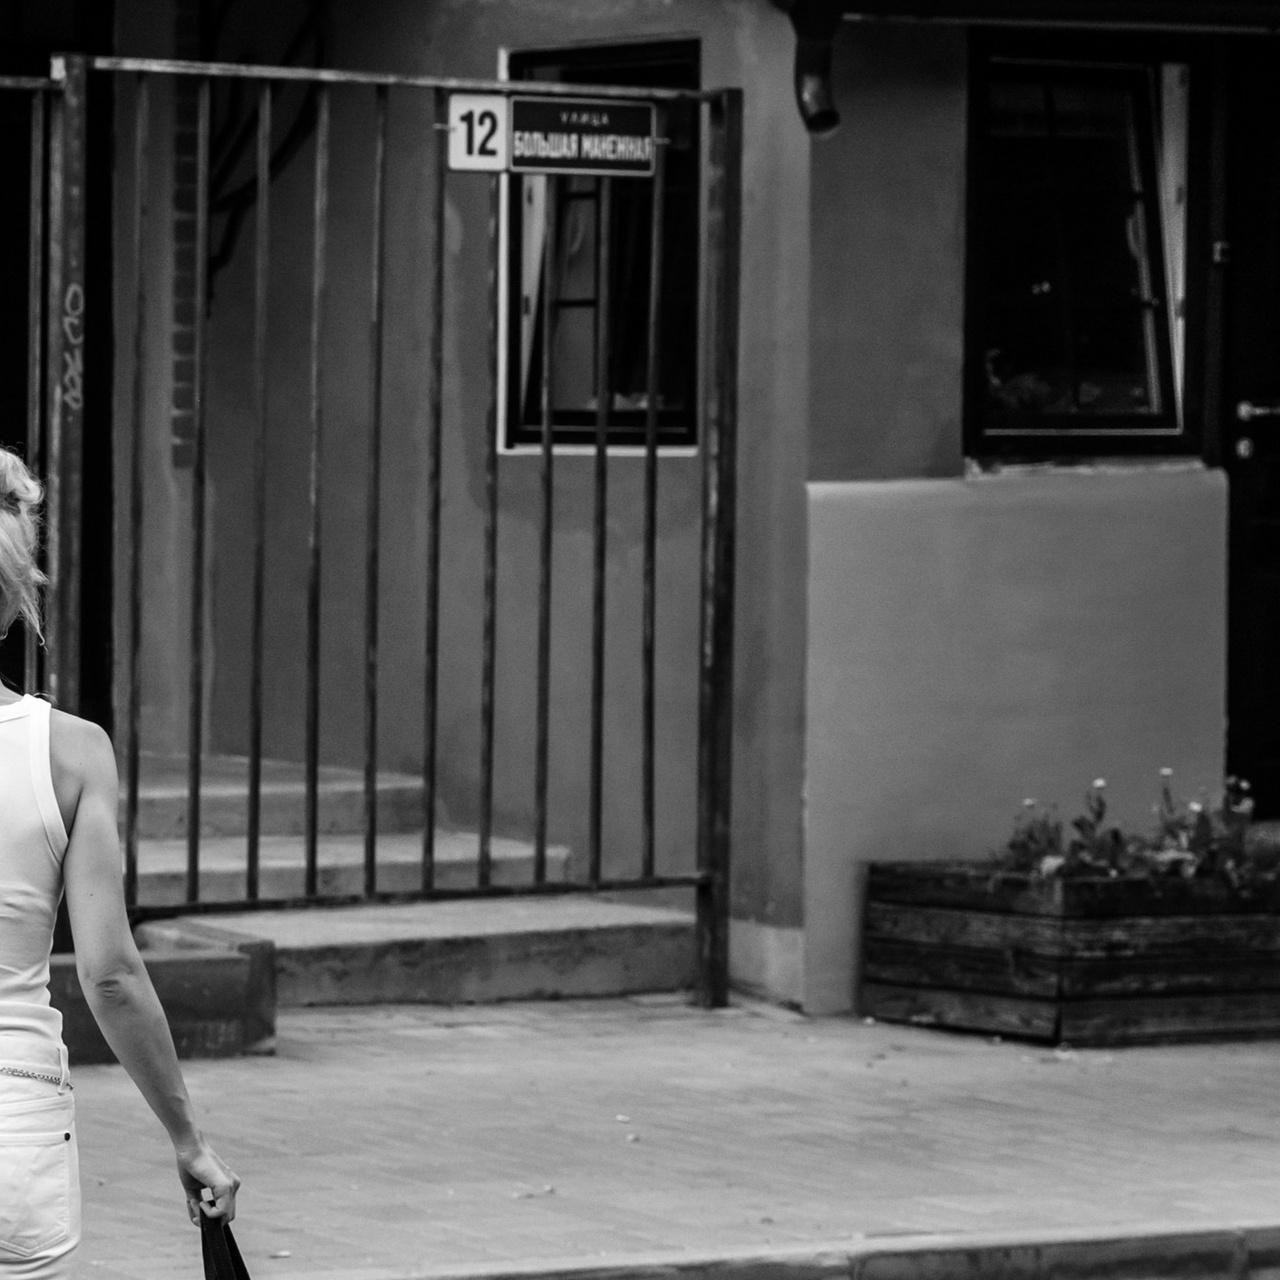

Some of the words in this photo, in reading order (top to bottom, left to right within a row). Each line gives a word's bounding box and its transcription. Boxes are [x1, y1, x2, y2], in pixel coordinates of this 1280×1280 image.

[459, 110, 498, 157] 12
[560, 111, 610, 127] УЛИЦА
[514, 130, 579, 159] БОЛЬШАЯ
